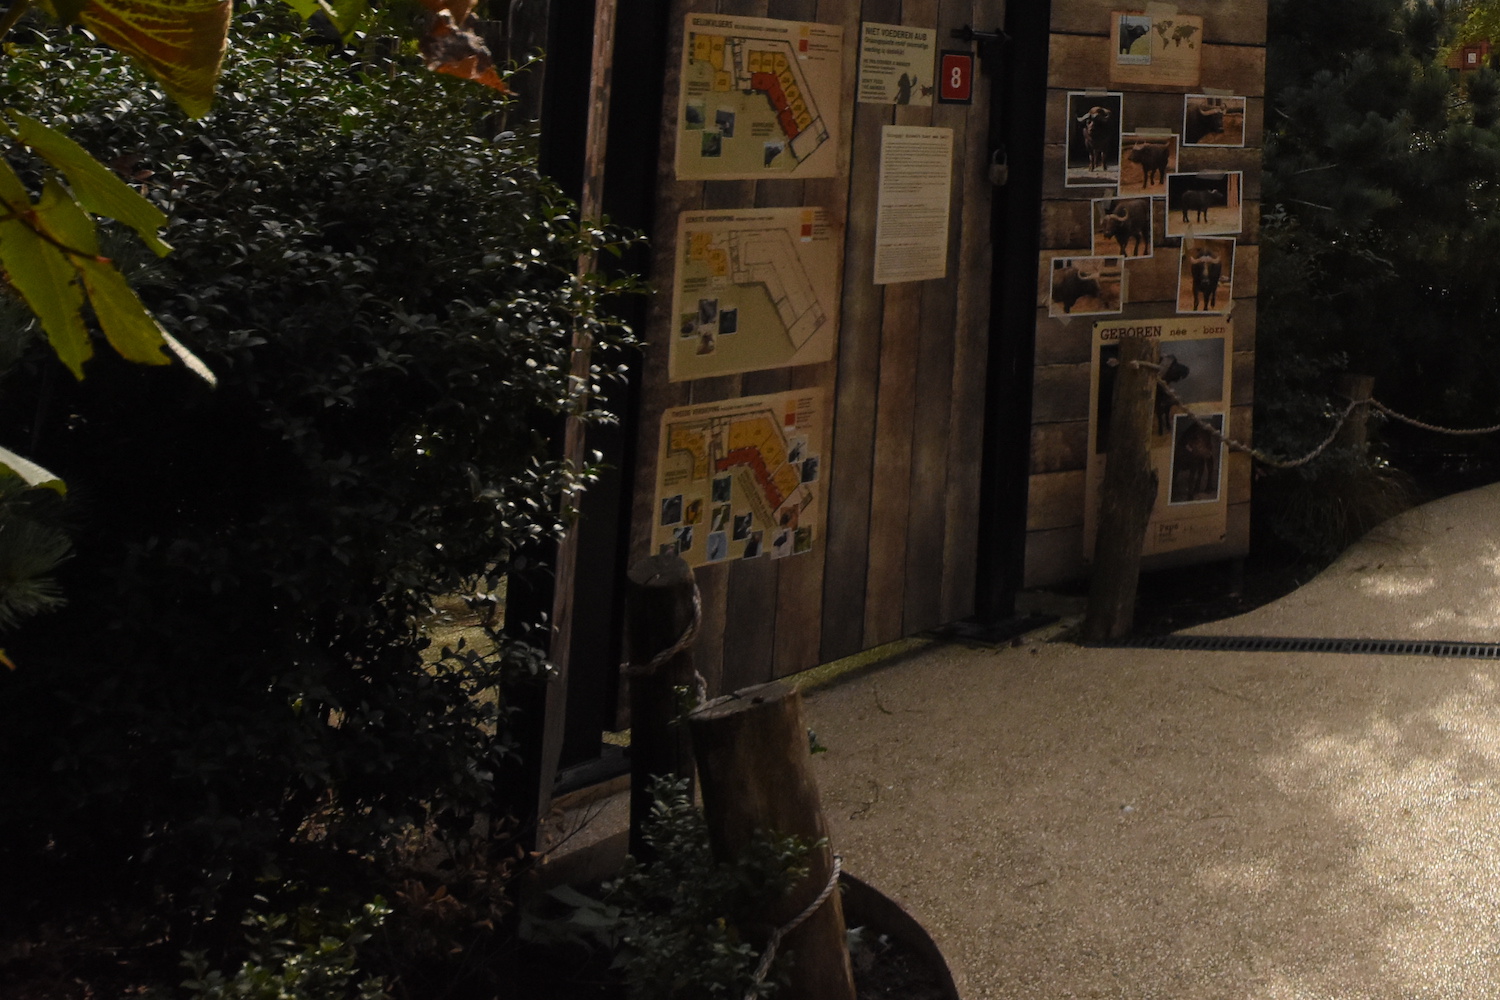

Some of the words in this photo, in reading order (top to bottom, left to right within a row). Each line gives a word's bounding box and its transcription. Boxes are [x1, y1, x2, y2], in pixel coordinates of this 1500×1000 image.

[865, 27, 880, 35] NIET
[881, 29, 914, 39] VOEDEREN
[914, 33, 927, 41] AUB
[950, 67, 962, 88] 8
[1100, 326, 1162, 340] GEBOREN
[1203, 326, 1226, 335] born
